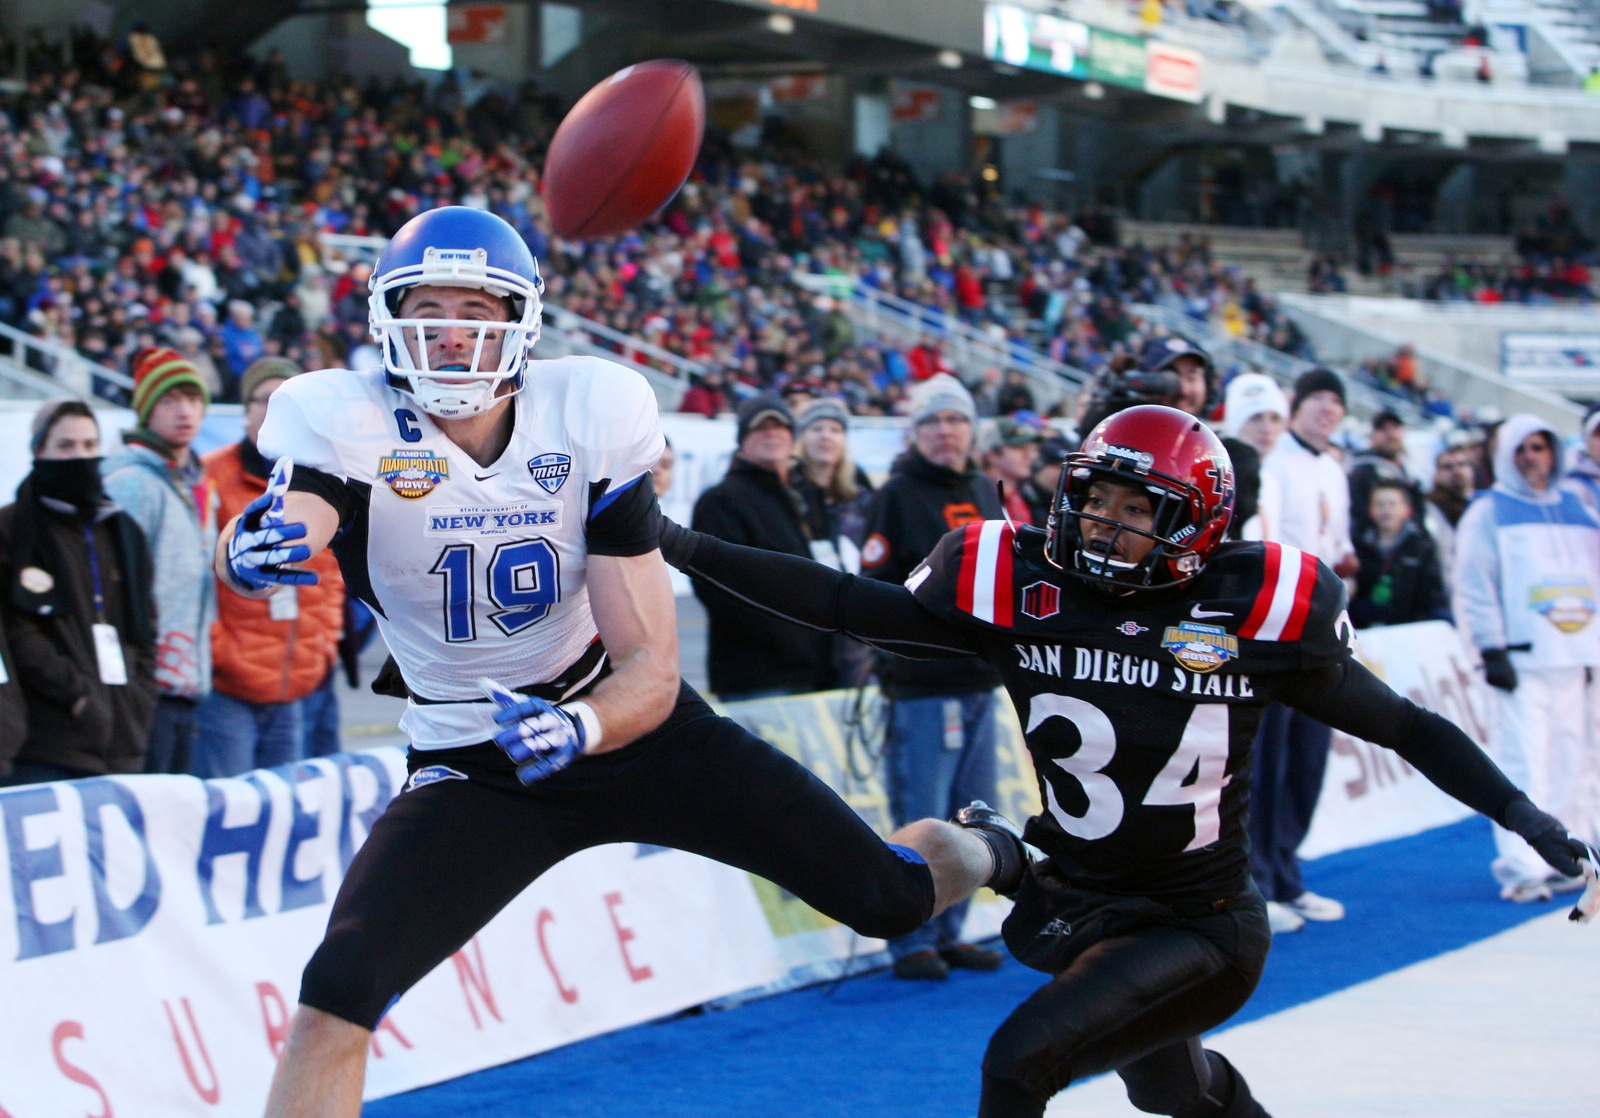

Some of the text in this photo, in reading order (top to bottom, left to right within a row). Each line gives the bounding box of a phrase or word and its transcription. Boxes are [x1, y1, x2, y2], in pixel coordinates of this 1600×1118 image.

[394, 408, 422, 442] C
[381, 458, 447, 474] IDAHO POTATO
[532, 464, 569, 479] MAC
[395, 480, 431, 489] BOWL
[481, 505, 518, 513] UNIVERSITY
[431, 511, 556, 530] NEW YORK
[427, 536, 561, 642] 19
[1015, 643, 1254, 698] SAN DIEGO STATE
[1025, 692, 1232, 853] 34
